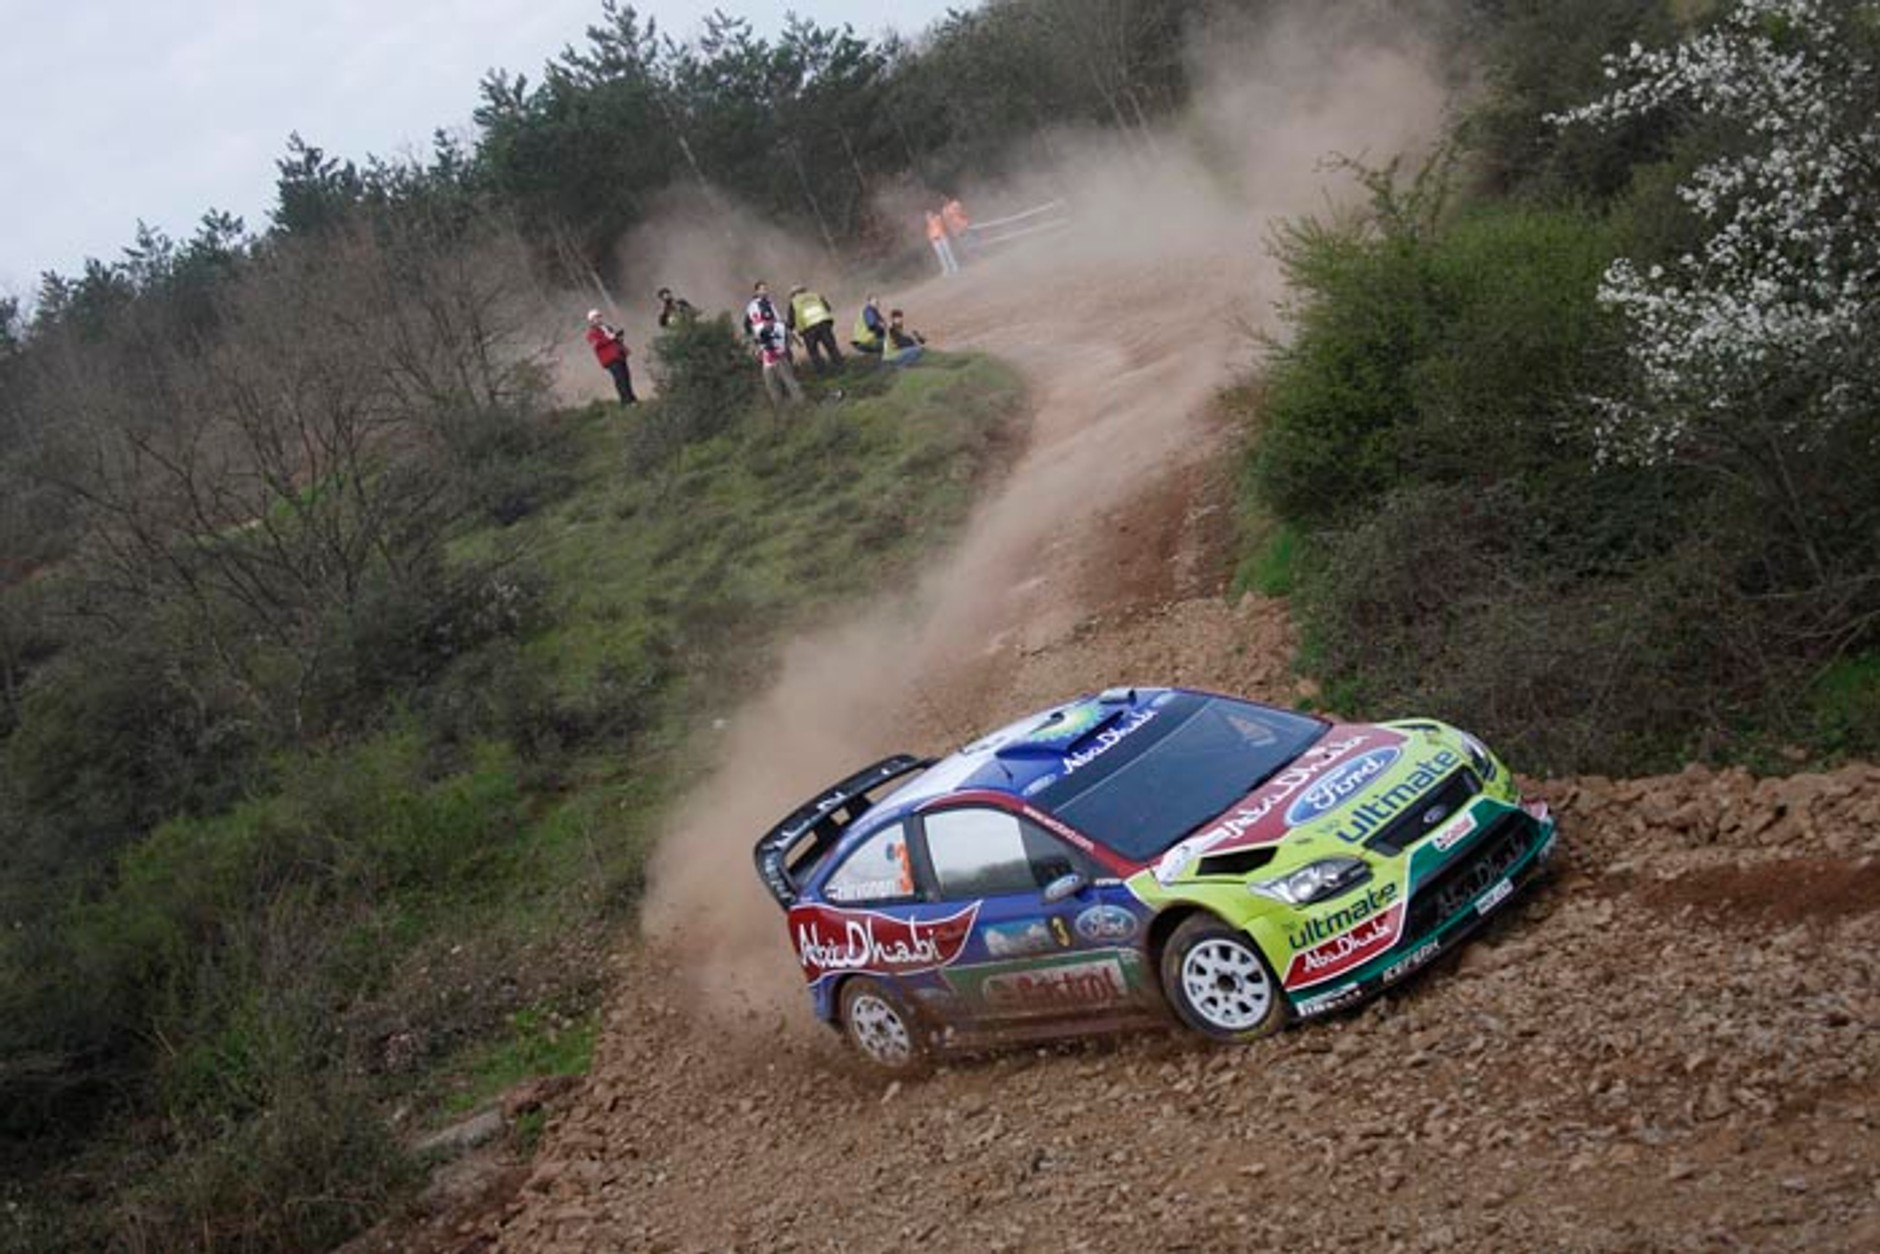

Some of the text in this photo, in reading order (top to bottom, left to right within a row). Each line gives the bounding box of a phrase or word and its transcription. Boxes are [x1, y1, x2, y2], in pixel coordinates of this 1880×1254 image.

[1306, 757, 1386, 810] Ford
[1336, 750, 1460, 844] ultimate
[1052, 917, 1071, 947] 3
